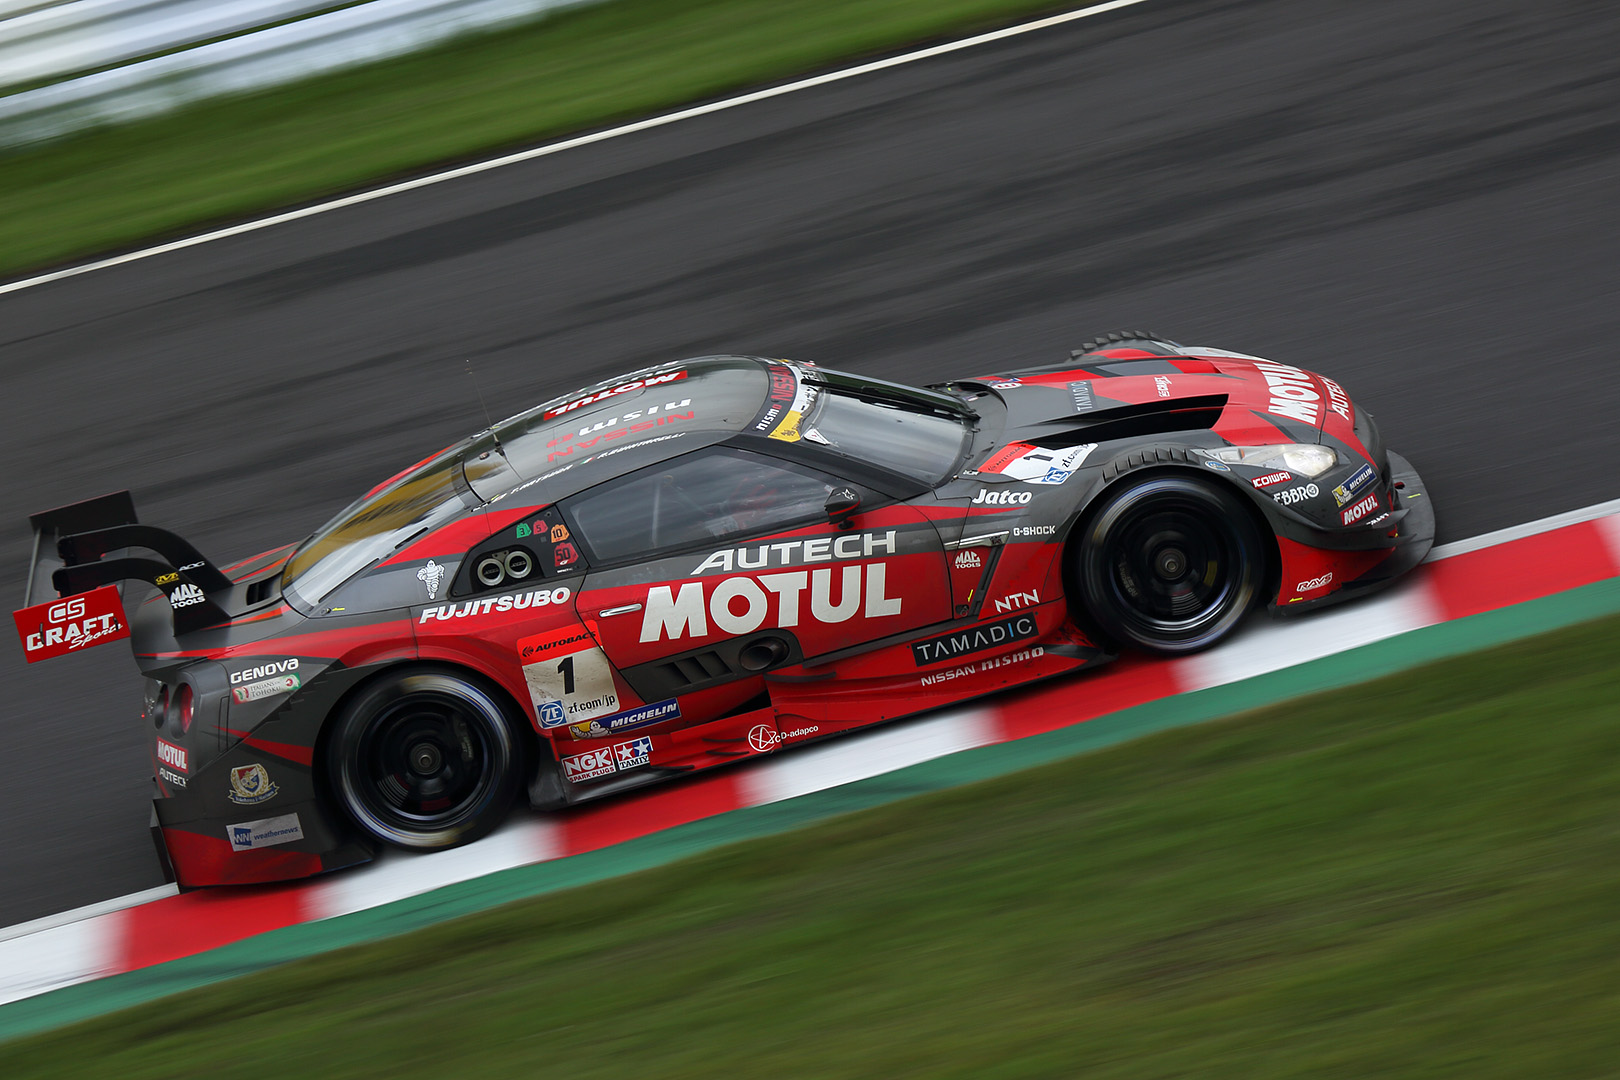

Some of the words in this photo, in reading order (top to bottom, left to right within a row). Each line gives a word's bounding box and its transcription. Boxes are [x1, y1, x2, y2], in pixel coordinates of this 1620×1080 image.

[549, 372, 681, 416] MOTUL
[768, 365, 795, 402] NISSAN
[1253, 362, 1320, 425] MOTUL
[756, 403, 782, 431] nismo
[547, 411, 695, 462] NISSAN
[1023, 453, 1054, 462] 1
[1349, 467, 1373, 490] MICHELIN
[972, 488, 1033, 505] Jatco
[1343, 495, 1378, 525] MOTUL
[552, 528, 563, 538] 10
[1013, 525, 1056, 536] G-SHOCK
[556, 548, 571, 562] 50
[690, 530, 896, 576] AUTECH
[955, 550, 980, 564] MAC
[170, 584, 204, 604] MAC
[171, 596, 206, 609] TOOLS
[418, 587, 571, 624] FUJITSUBO
[639, 562, 902, 643] MOTUL
[994, 588, 1040, 613] NTN
[27, 613, 114, 651] CRAFT
[69, 623, 123, 649] Sports
[535, 630, 596, 653] AUTOBACS
[917, 618, 1033, 660] TAMADIC
[557, 656, 575, 695] 1
[921, 665, 976, 687] NISSAN
[981, 646, 1045, 671] nismo
[542, 706, 561, 722] ZF
[568, 693, 616, 714] zf.com/jp
[610, 702, 677, 728] MICHELIN
[158, 741, 187, 769] MOTUL
[563, 750, 613, 776] NGK
[619, 755, 650, 769] TAMIY
[569, 772, 591, 783] SPARK
[592, 766, 615, 778] PLUGS
[253, 826, 299, 841] weathernews
